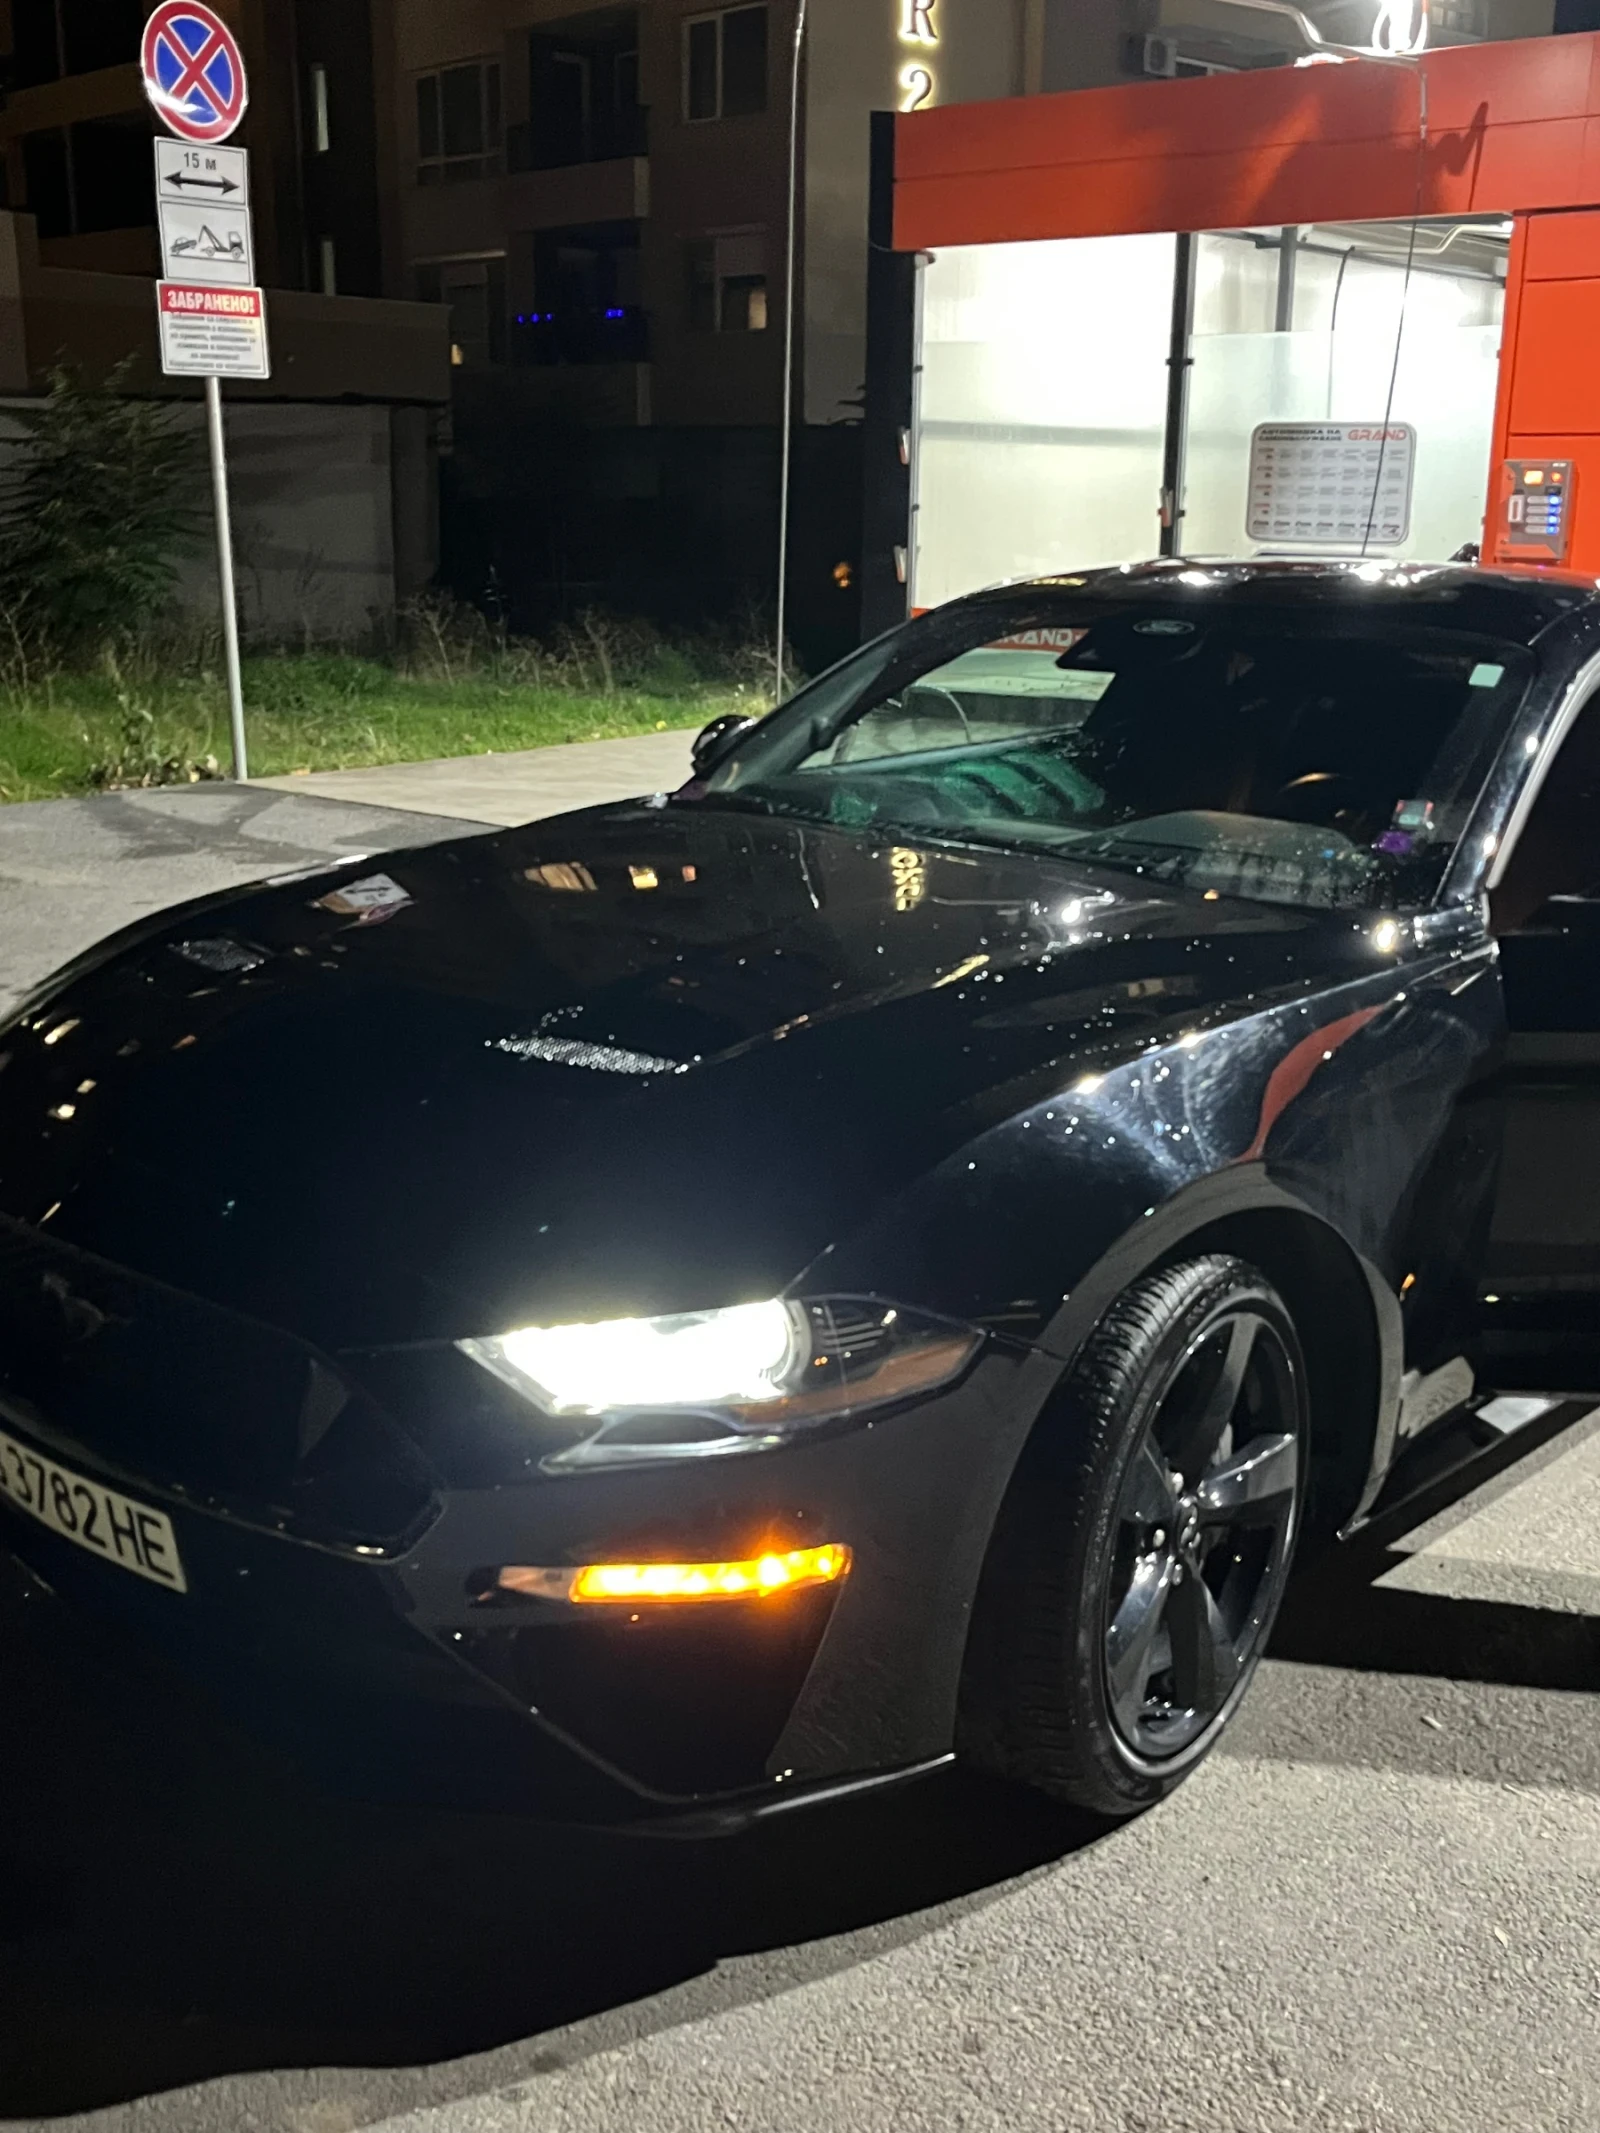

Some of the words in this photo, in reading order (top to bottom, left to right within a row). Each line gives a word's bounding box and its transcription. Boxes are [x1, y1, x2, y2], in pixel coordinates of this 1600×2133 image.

[183, 152, 200, 169] 15
[167, 289, 255, 314] ЗАБРАНЕНО!
[1347, 428, 1408, 441] GRAND
